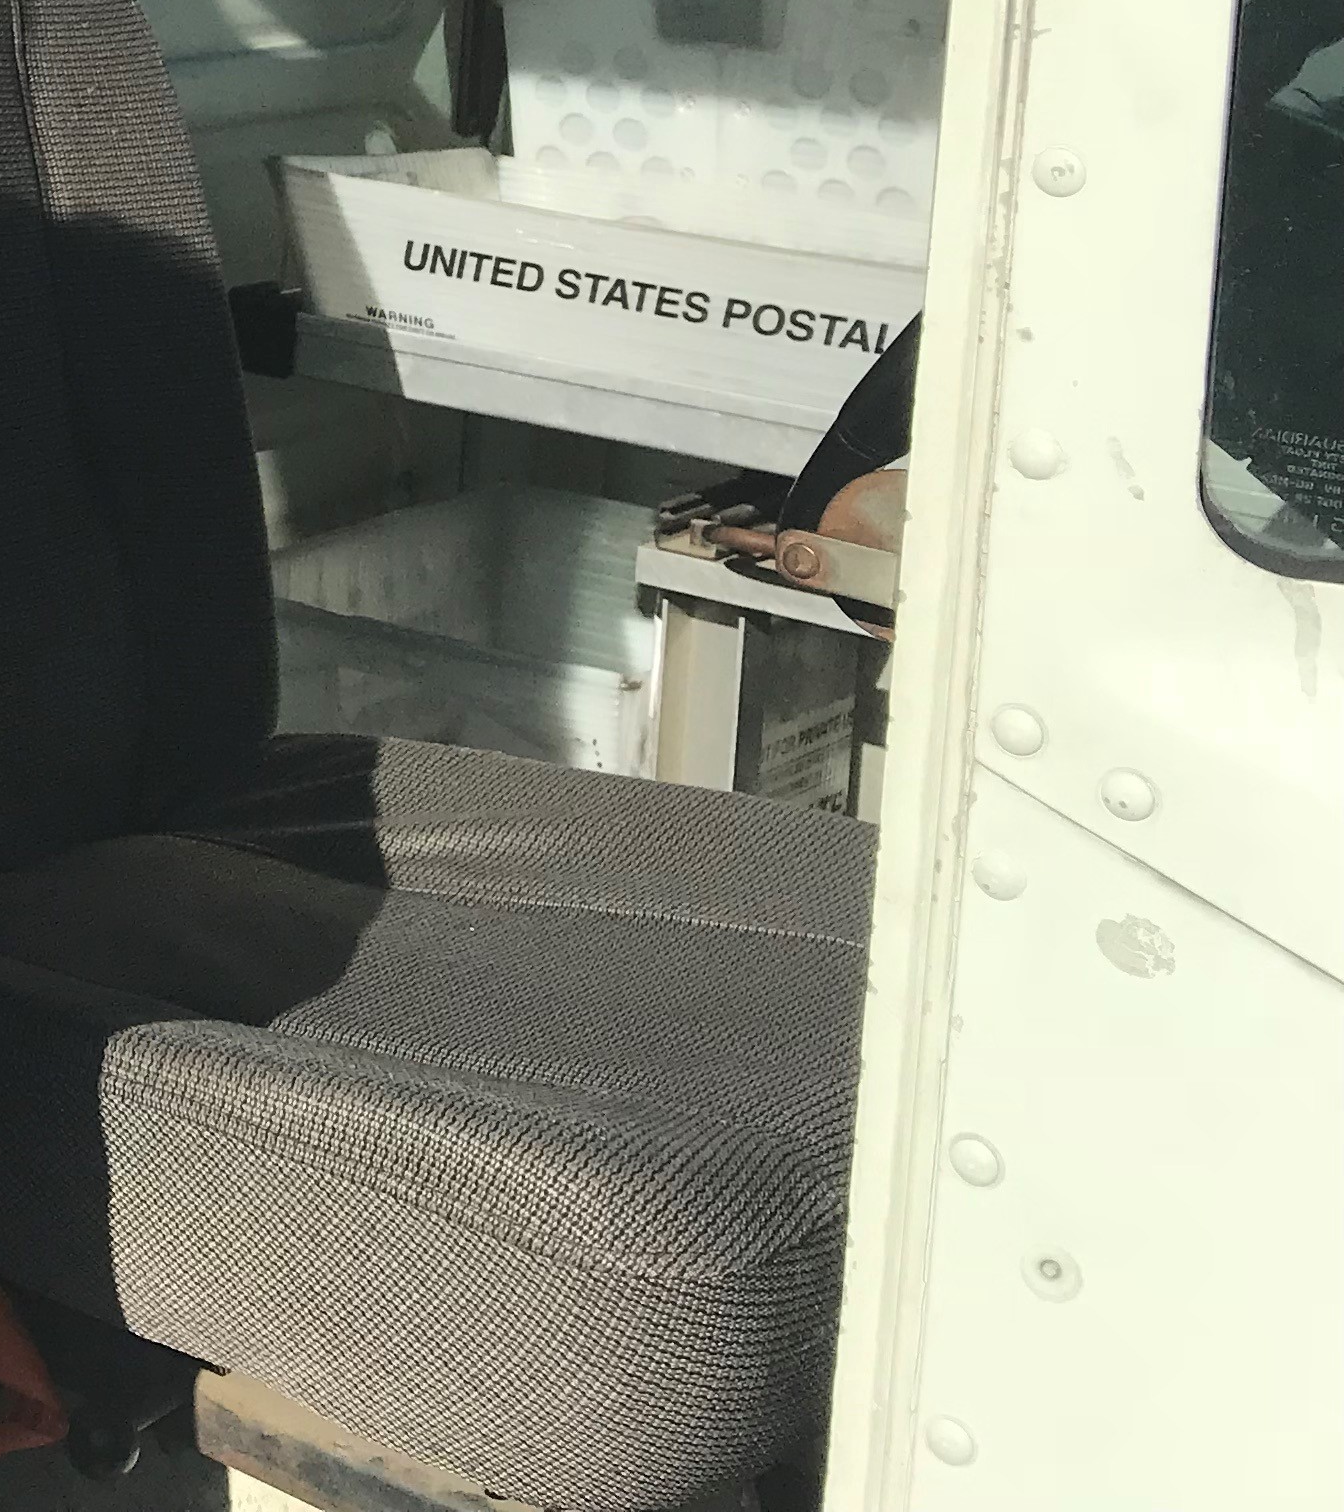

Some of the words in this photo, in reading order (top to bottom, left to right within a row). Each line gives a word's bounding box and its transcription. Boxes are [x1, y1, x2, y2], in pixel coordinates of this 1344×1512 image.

[403, 240, 544, 292] UNITED
[554, 268, 711, 324] STATES
[365, 305, 434, 330] WARNING
